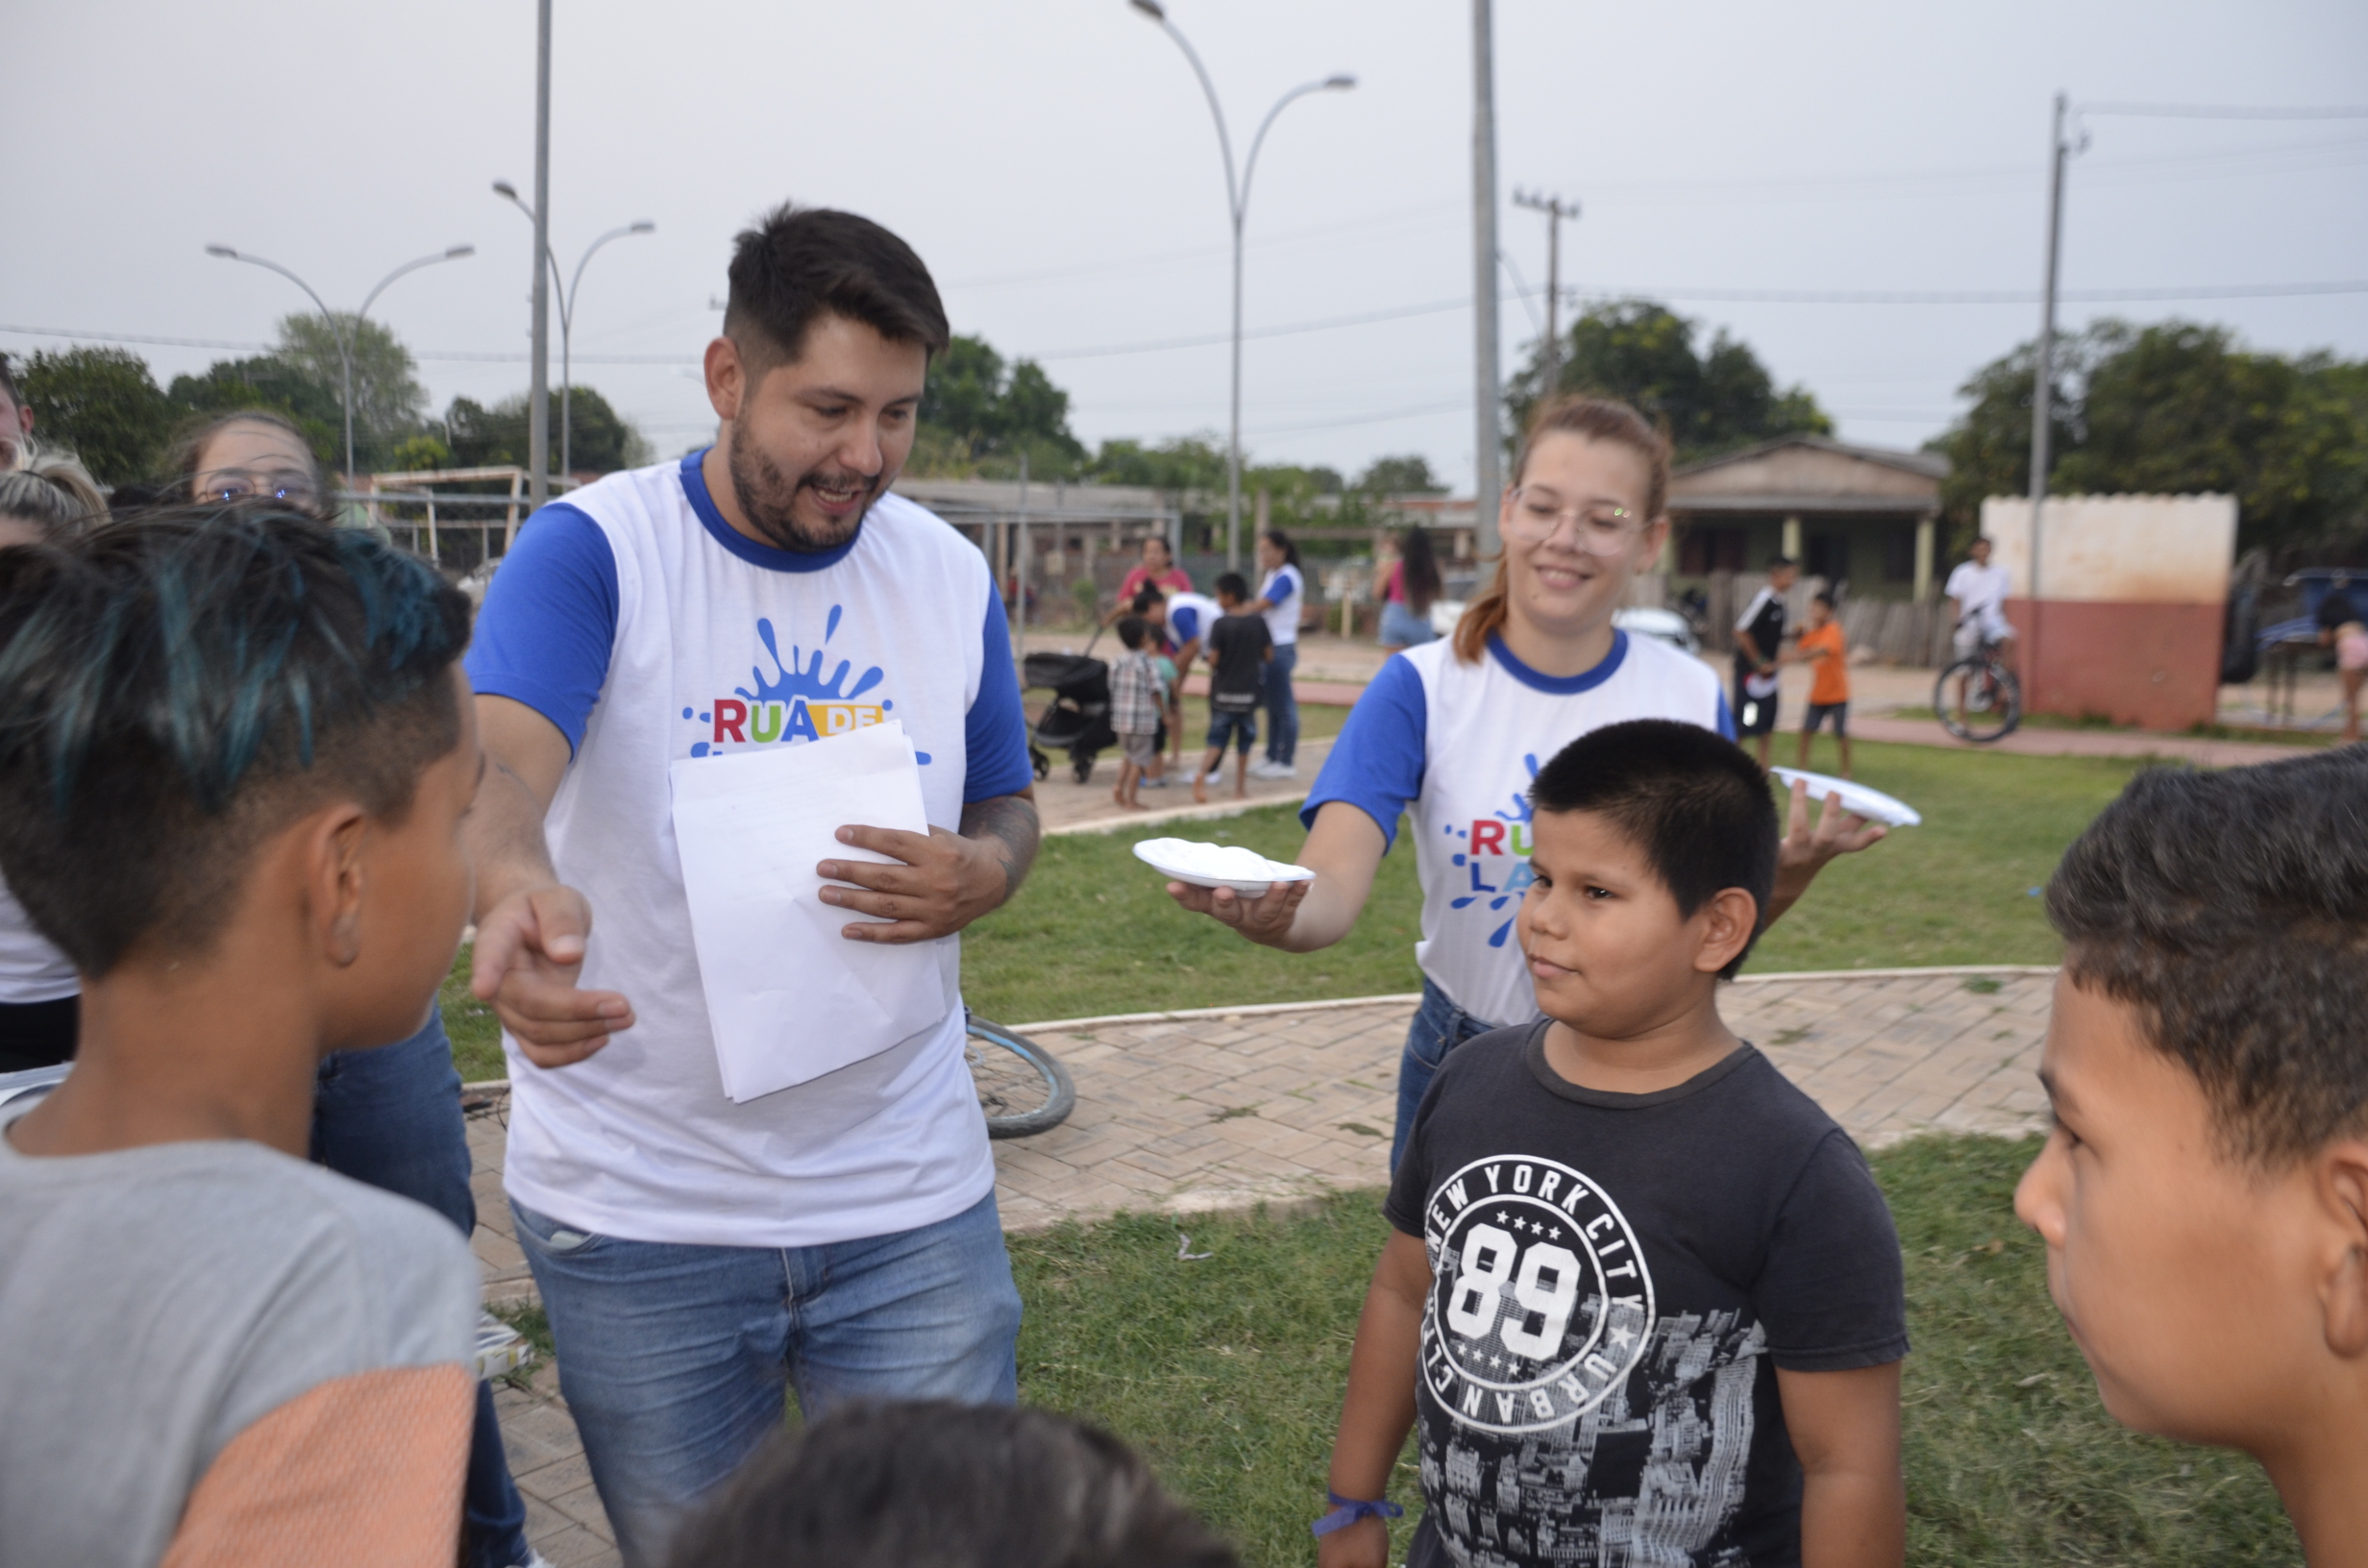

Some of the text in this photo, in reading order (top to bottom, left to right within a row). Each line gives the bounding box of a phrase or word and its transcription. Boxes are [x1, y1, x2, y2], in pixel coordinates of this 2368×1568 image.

[713, 698, 820, 744] RUA
[1469, 820, 1534, 856] RU
[1470, 862, 1535, 893] LA
[1424, 1164, 1644, 1311] NEW YORK CITY
[1446, 1222, 1582, 1361] 89
[1462, 1353, 1618, 1424] URBAN
